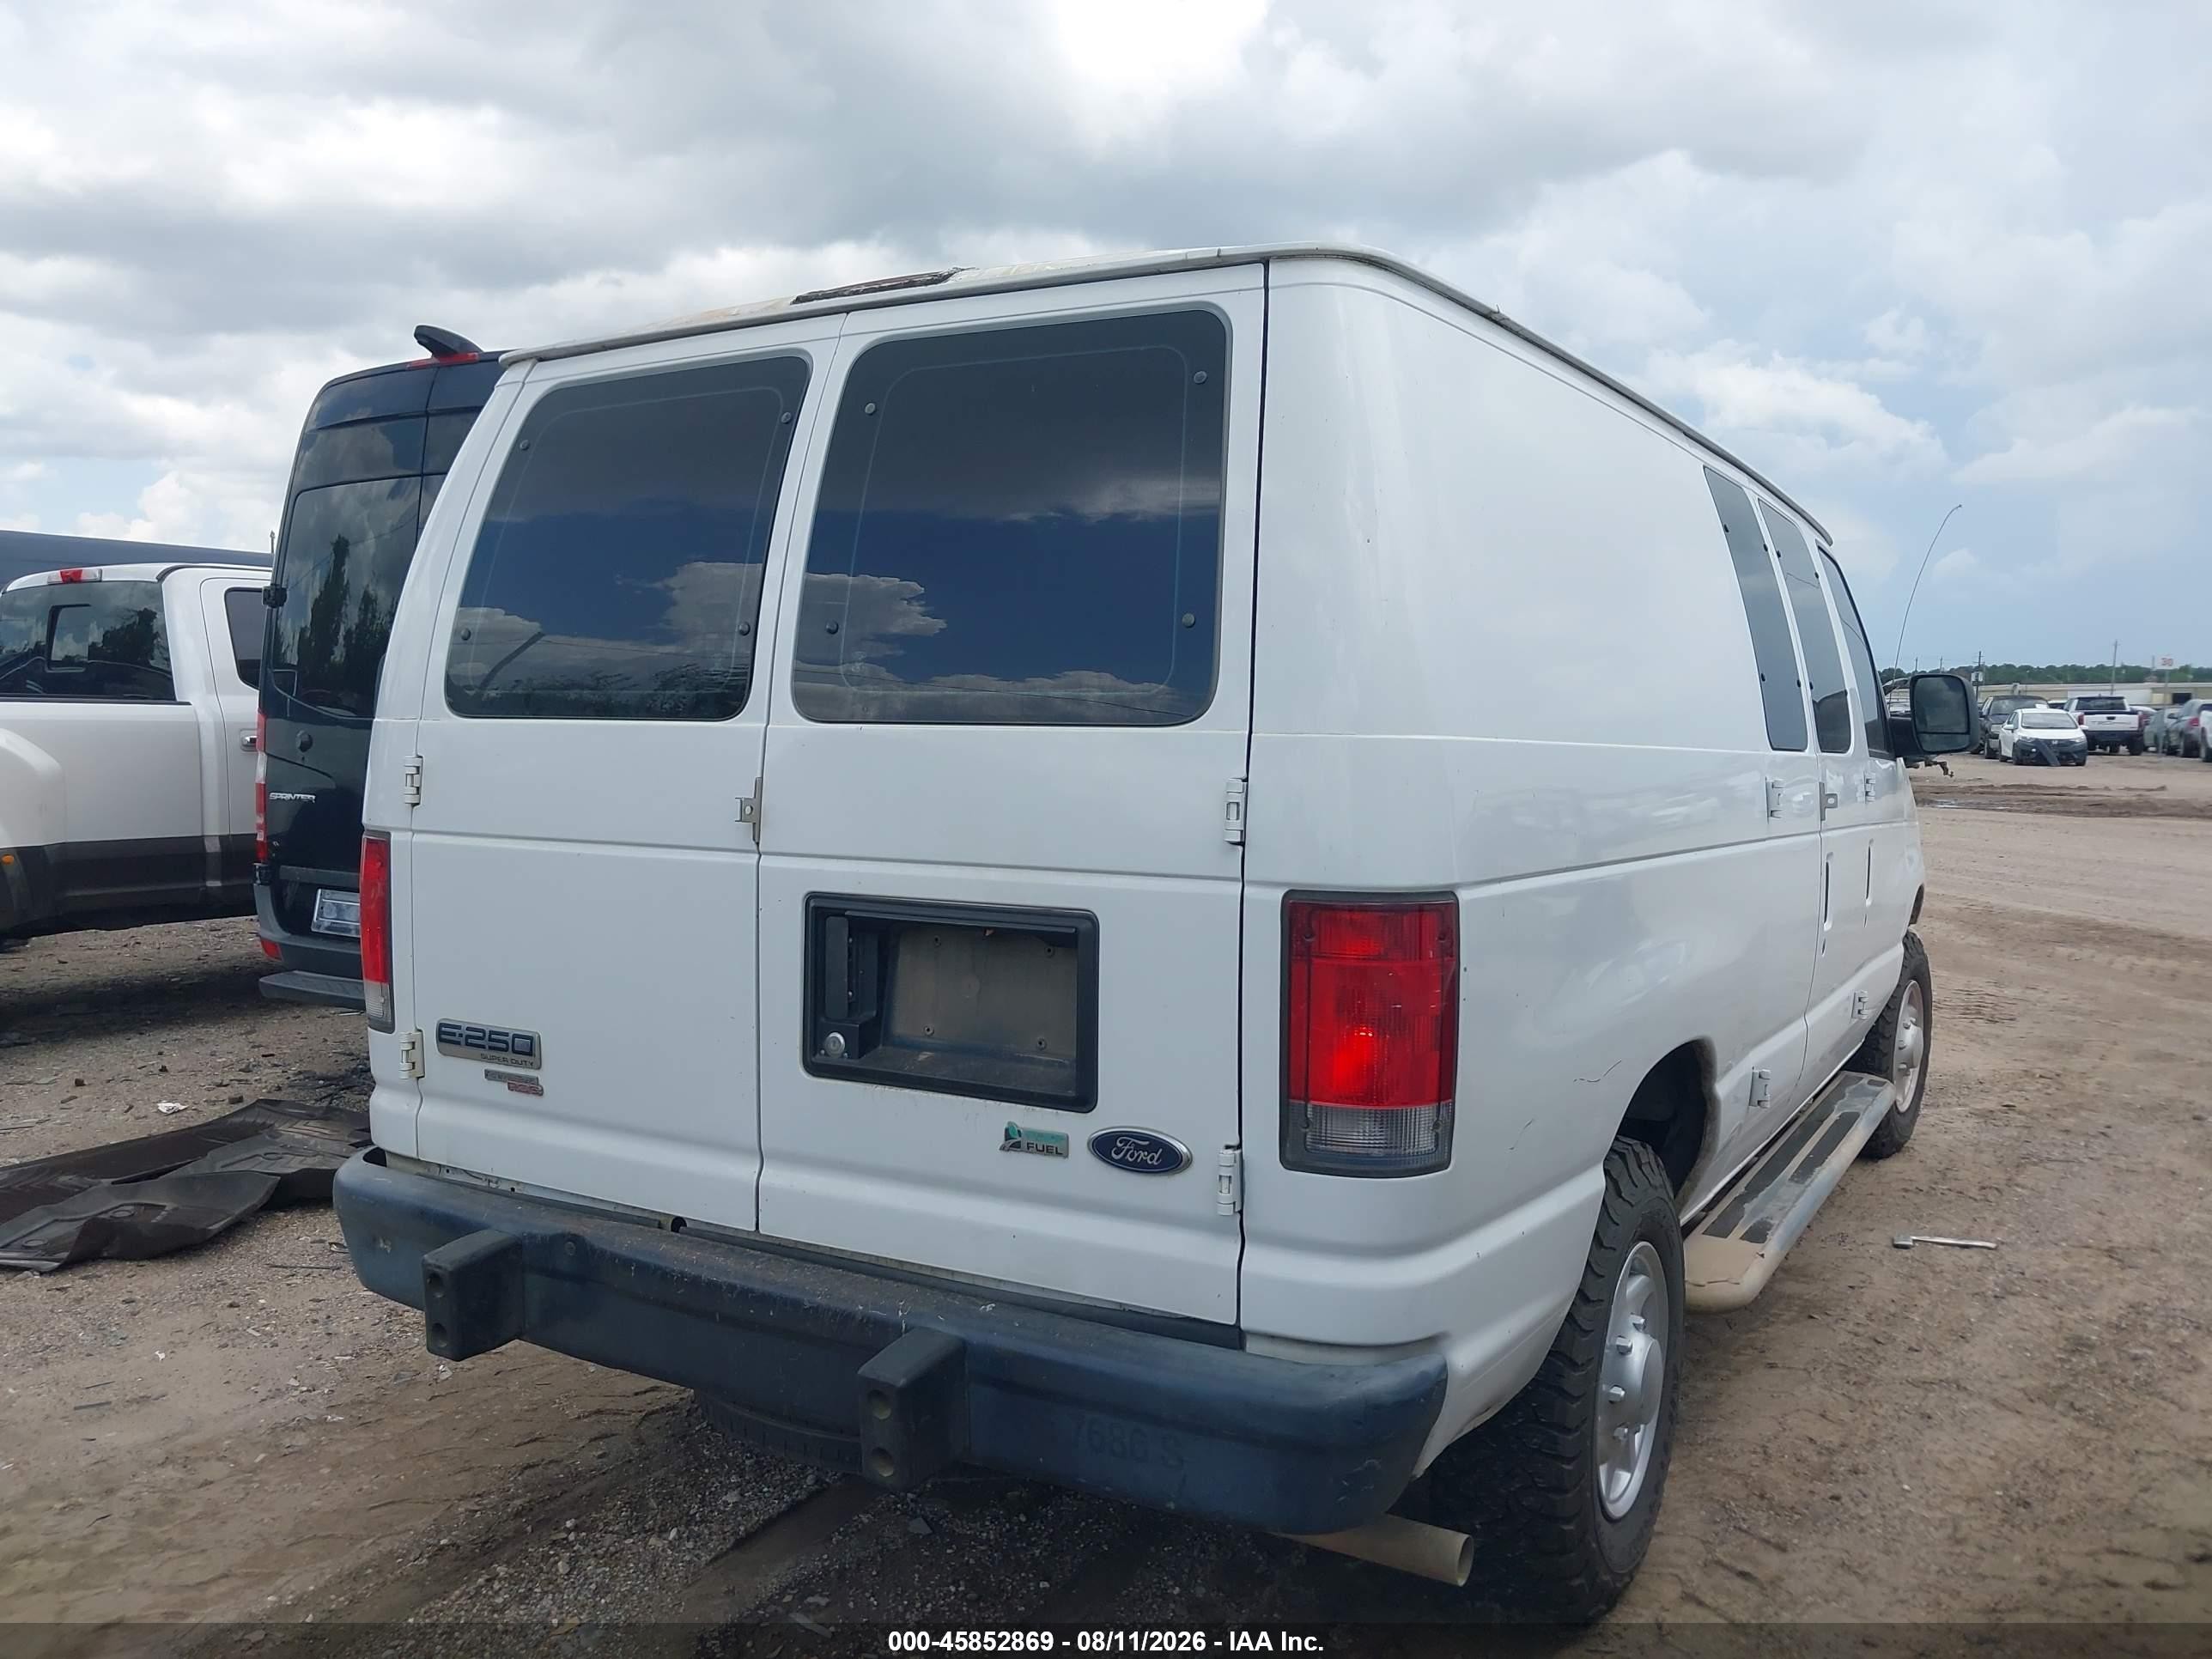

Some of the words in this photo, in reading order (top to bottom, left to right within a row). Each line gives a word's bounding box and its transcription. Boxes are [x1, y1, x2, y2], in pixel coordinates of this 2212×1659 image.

[269, 792, 316, 803] SPRINTER
[480, 1053, 509, 1064] SUPER
[510, 1058, 534, 1067] DUTY
[1026, 1142, 1064, 1155] FUEL
[1110, 1136, 1163, 1165] Ford
